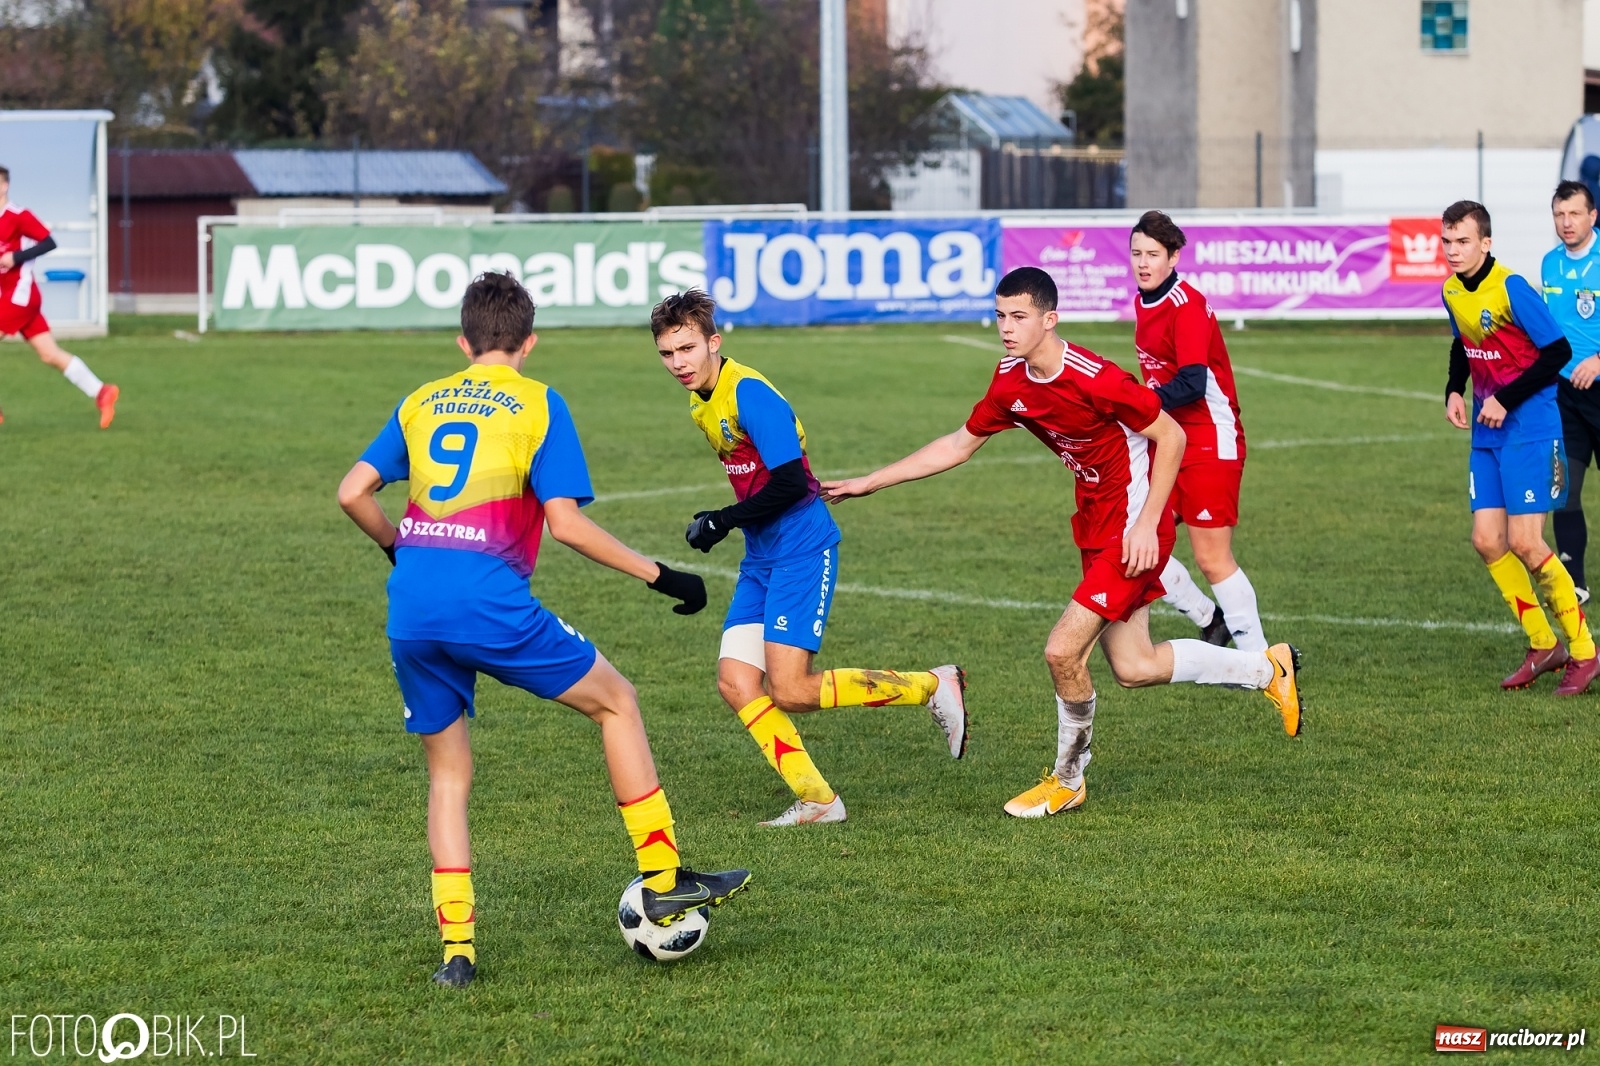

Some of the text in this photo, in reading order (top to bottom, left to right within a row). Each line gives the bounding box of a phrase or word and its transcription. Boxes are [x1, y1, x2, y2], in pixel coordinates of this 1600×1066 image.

[1194, 239, 1338, 265] MIESZALNIA
[222, 242, 707, 310] McDonald's
[712, 231, 997, 313] joma
[1237, 270, 1363, 296] TIKKURILA
[432, 400, 498, 418] ROGÓW
[428, 421, 479, 502] 9
[412, 521, 487, 542] SZCZYRBA
